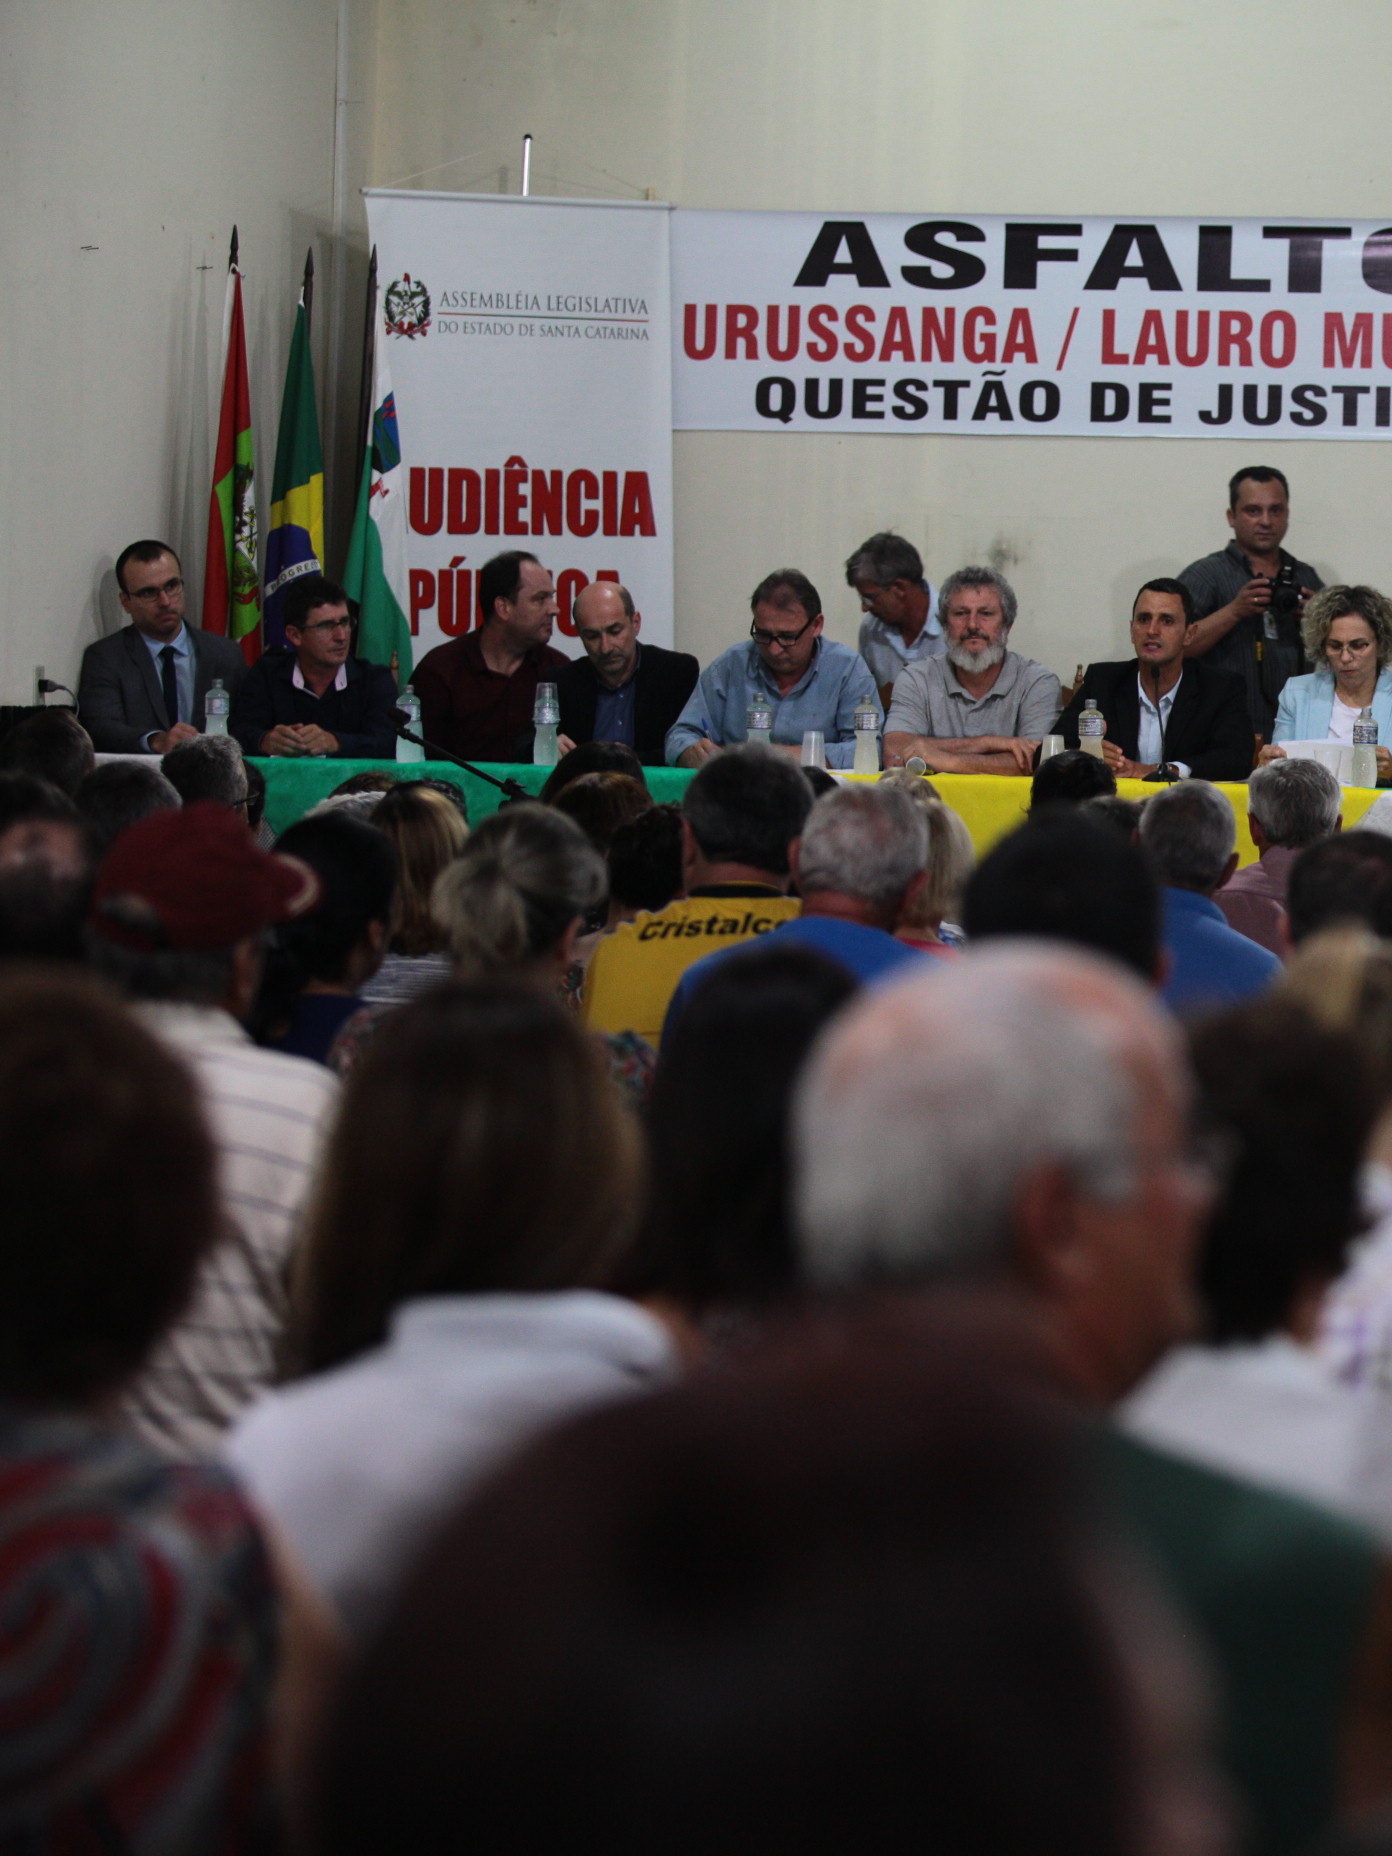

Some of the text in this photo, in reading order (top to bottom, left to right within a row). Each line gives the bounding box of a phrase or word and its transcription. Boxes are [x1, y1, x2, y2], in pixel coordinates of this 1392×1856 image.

[439, 290, 649, 315] ASSEMBLÉIA LEGISLATIVA
[437, 320, 649, 341] DO ESTADO DE SANTA CATARINA
[683, 303, 1039, 364] URUSSANGA
[1101, 308, 1297, 369] LAURO
[755, 369, 1061, 424] QUESTÃO
[1090, 381, 1173, 424] DE
[408, 455, 657, 538] UDIÊNCIA
